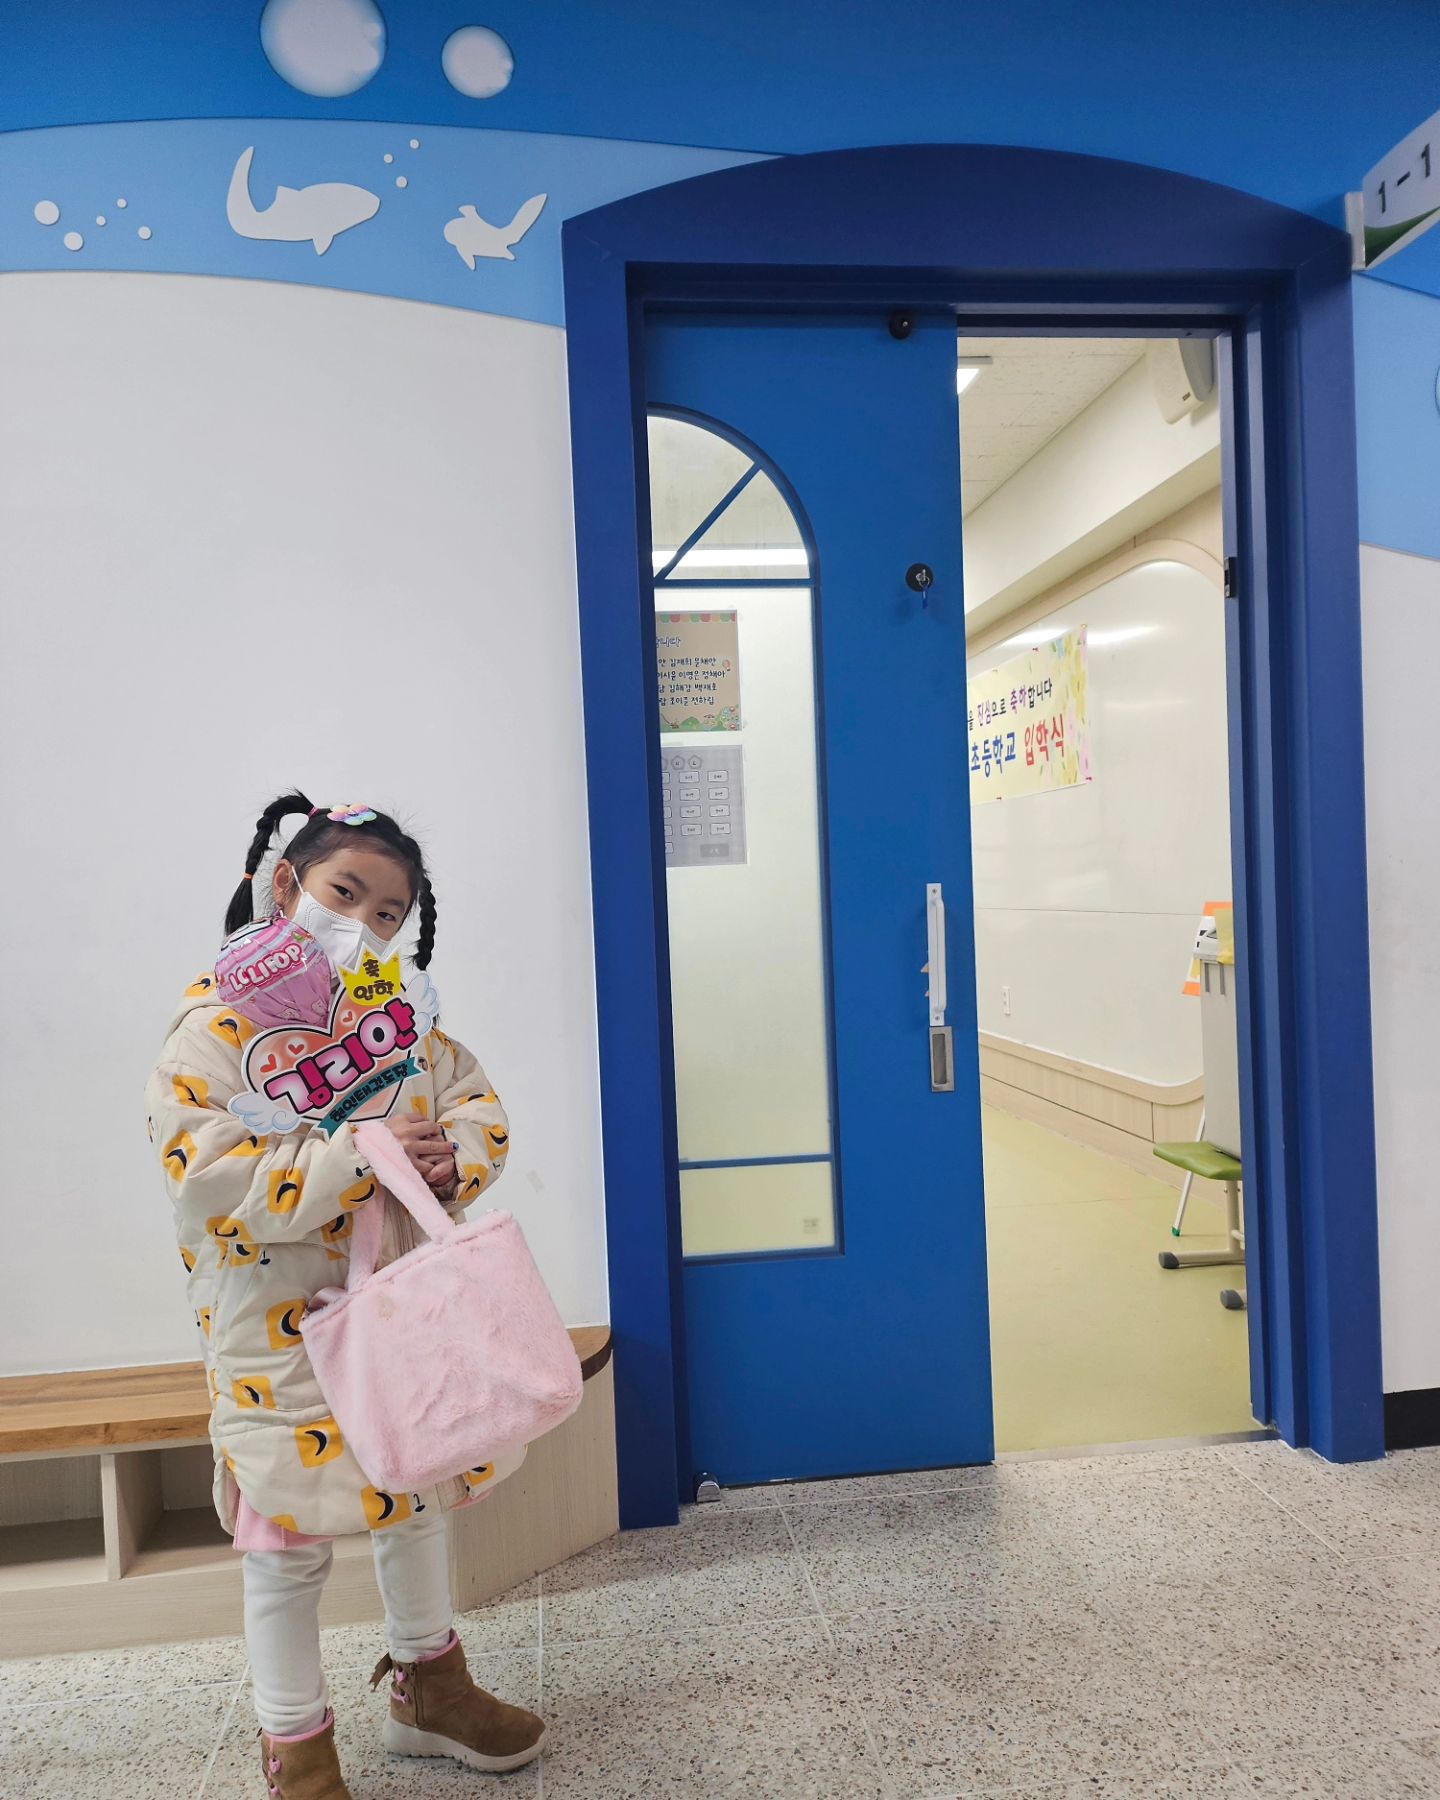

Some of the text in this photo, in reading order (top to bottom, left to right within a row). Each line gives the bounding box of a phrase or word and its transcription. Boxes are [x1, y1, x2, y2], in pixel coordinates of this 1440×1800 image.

[977, 698, 1007, 727] 진심으로
[1010, 677, 1053, 714] 축하합니다
[971, 713, 1065, 778] 초등학교 입학식
[352, 979, 395, 1001] 입학
[264, 998, 418, 1114] 김리안
